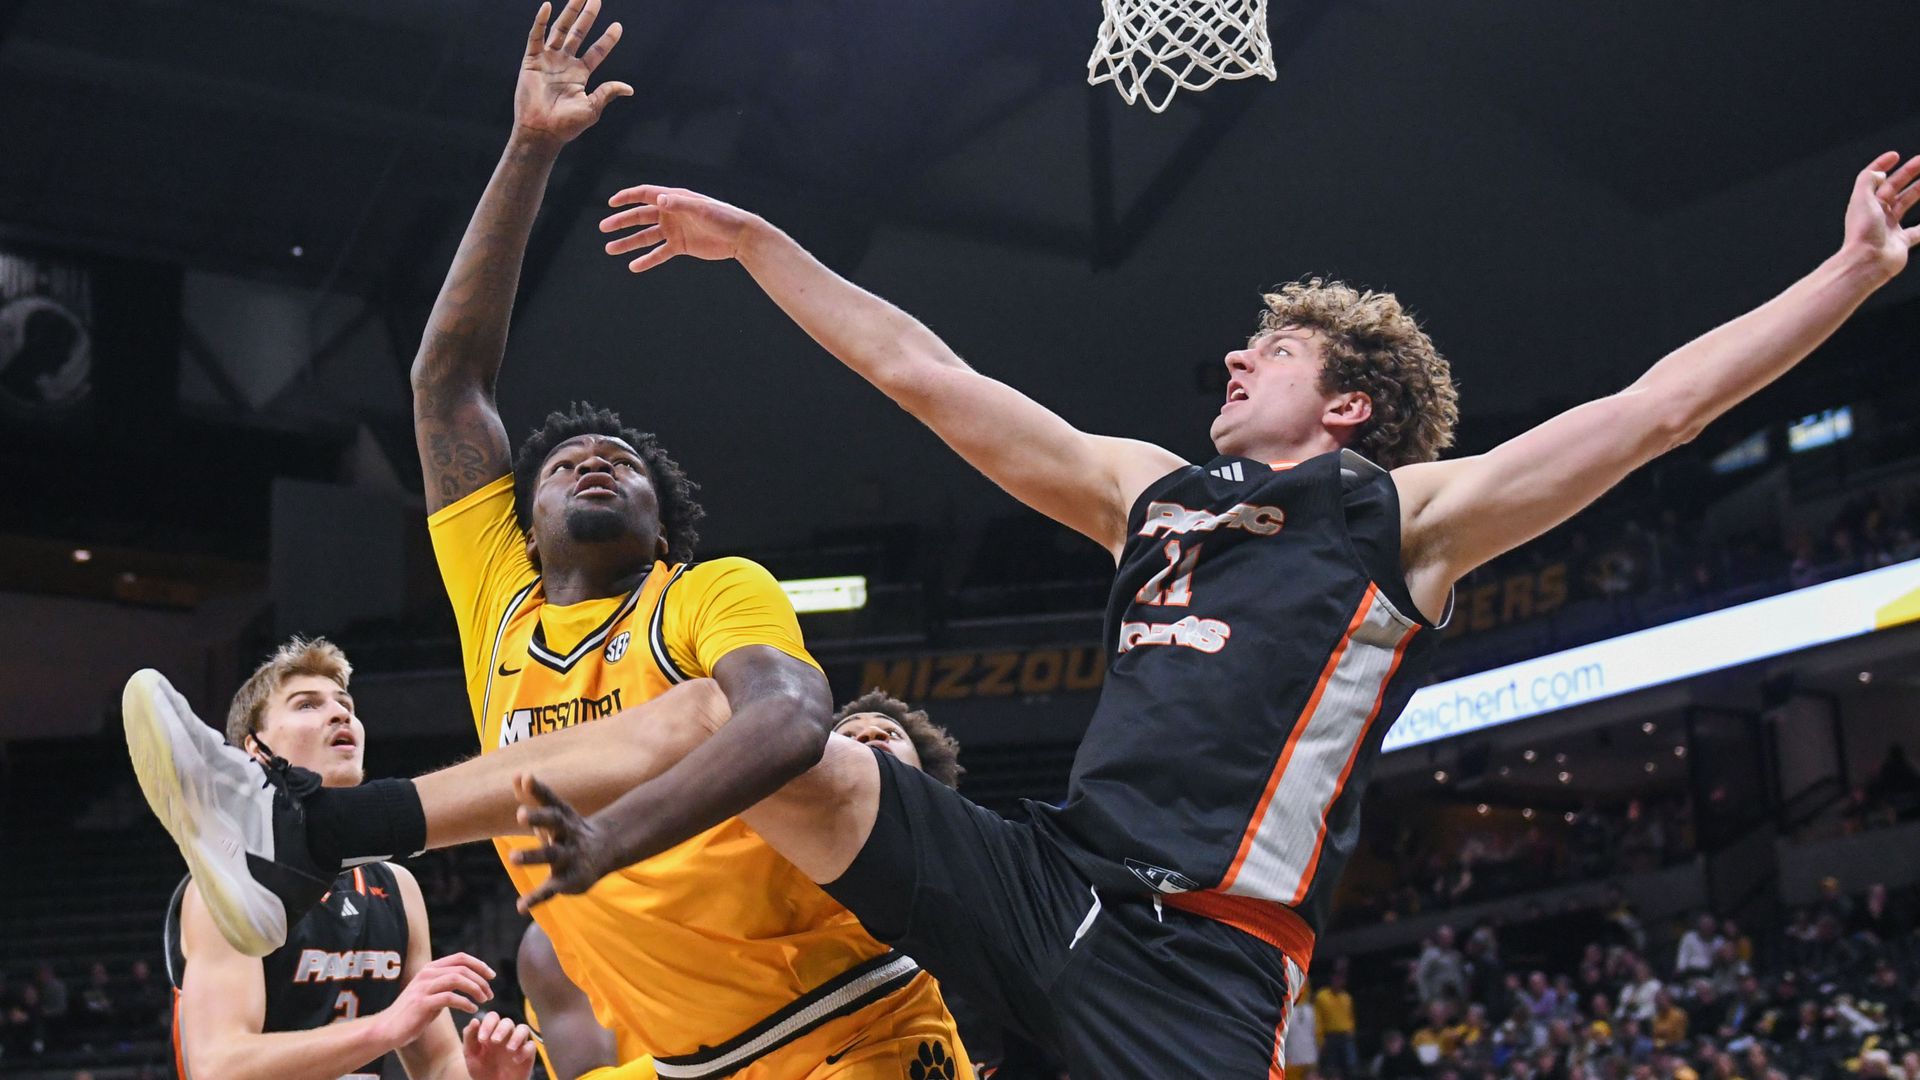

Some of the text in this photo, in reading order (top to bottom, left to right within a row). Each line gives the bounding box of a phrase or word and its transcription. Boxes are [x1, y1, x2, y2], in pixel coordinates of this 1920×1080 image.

[605, 631, 631, 663] SEC
[860, 646, 1107, 698] MIZZOU
[499, 688, 623, 749] MISSOURI
[293, 949, 402, 983] PACIFIC
